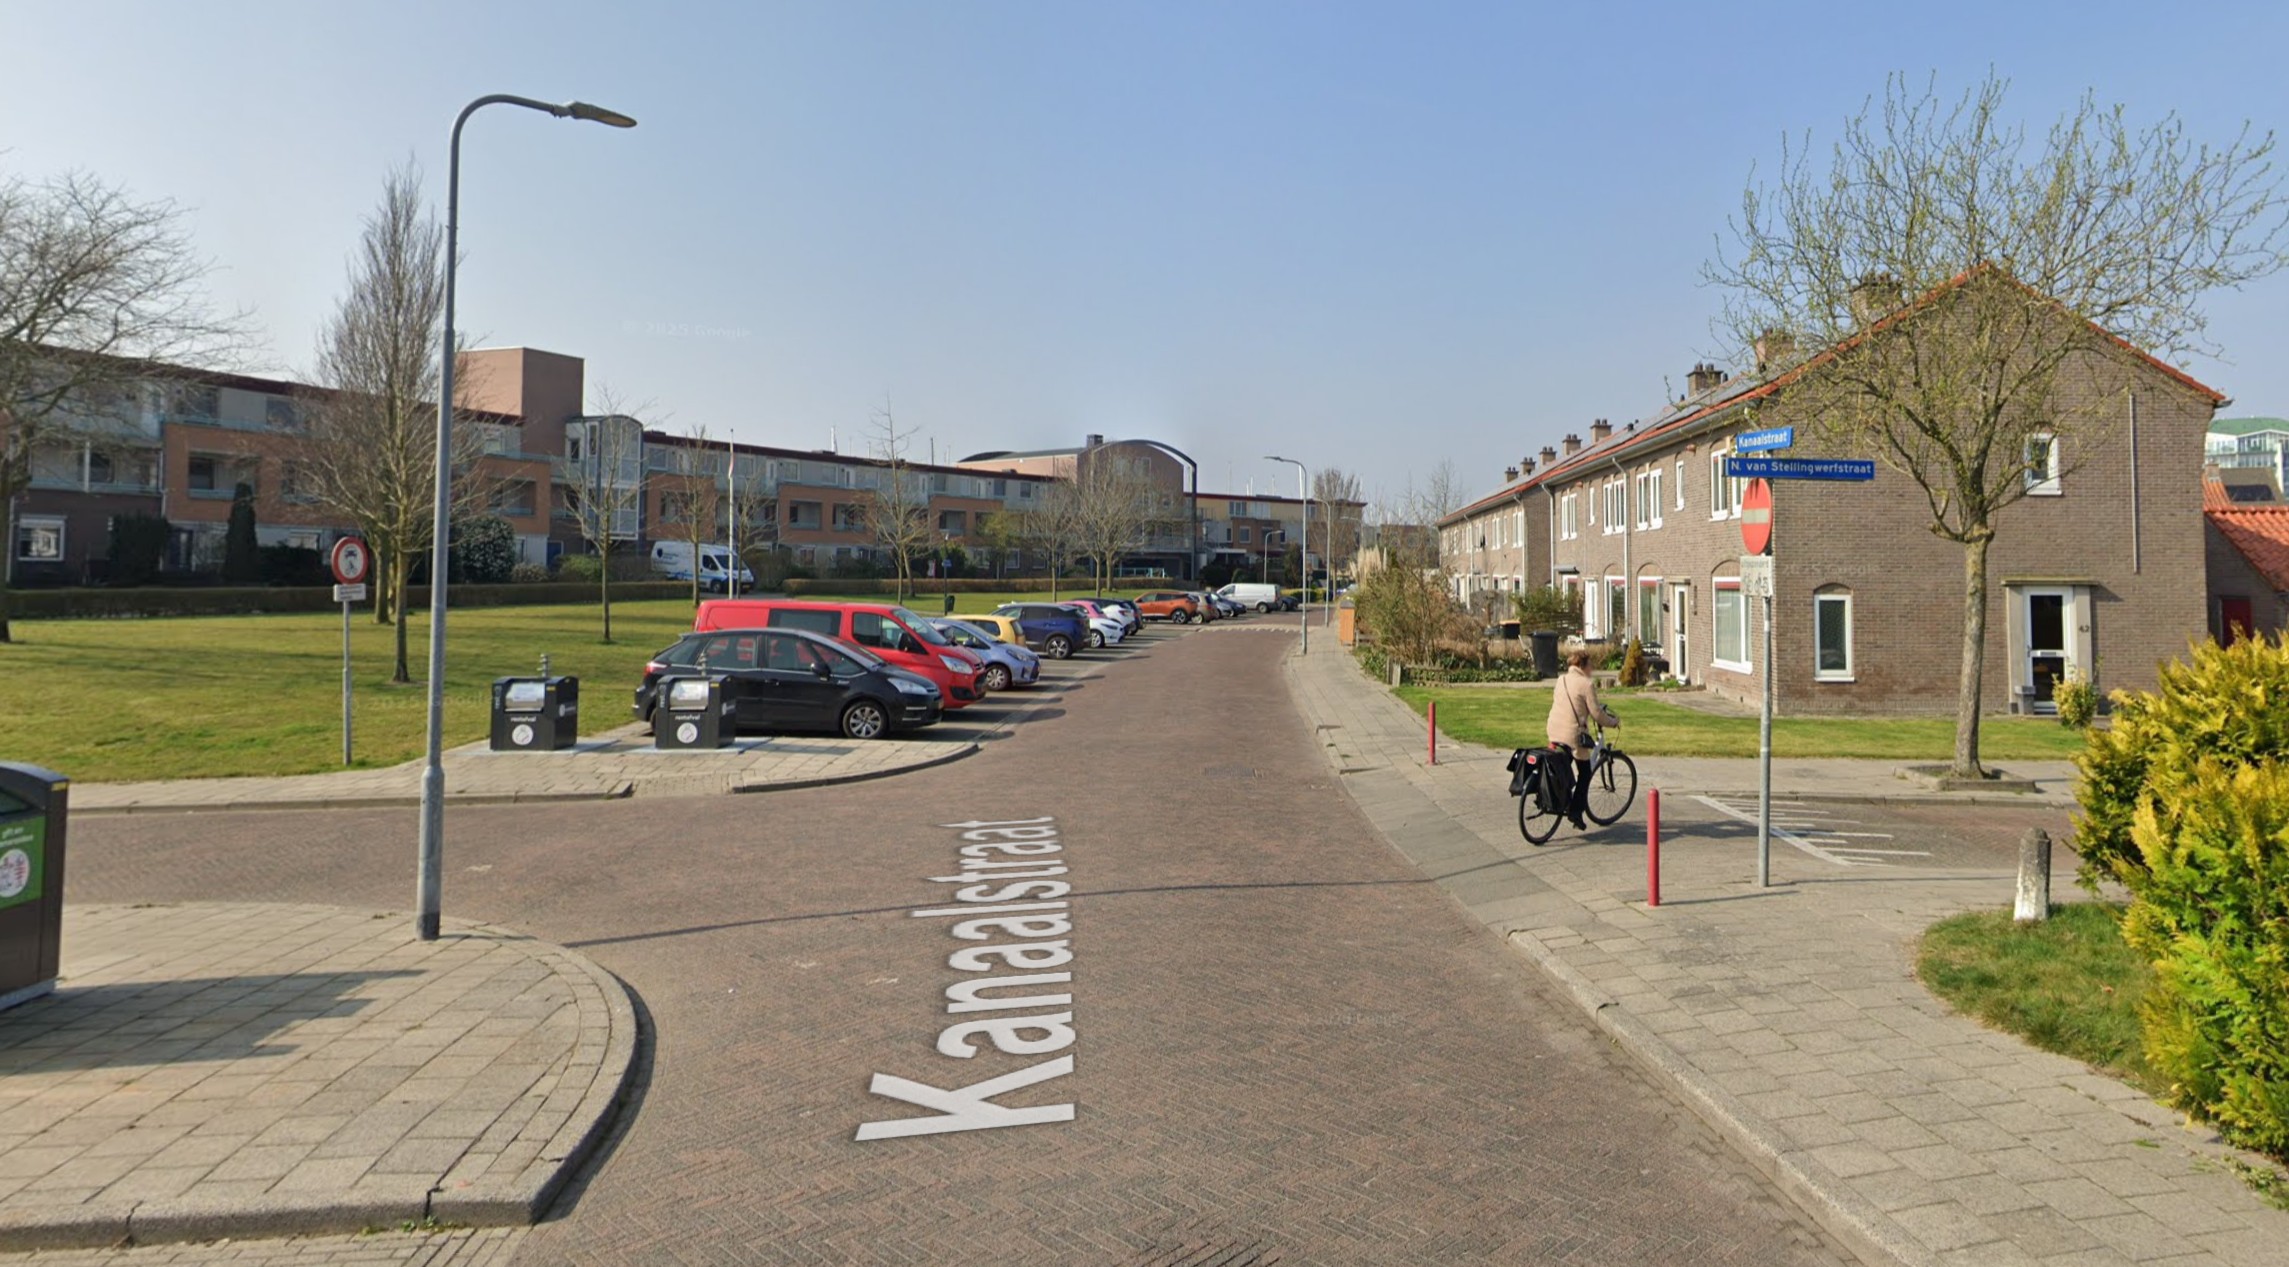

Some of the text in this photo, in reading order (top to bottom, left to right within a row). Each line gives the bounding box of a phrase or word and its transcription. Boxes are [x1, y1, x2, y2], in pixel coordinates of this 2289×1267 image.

[1739, 430, 1787, 448] Kanaalstraat
[1731, 461, 1871, 475] N. van Stellingwerfstraat
[2079, 624, 2090, 633] 42
